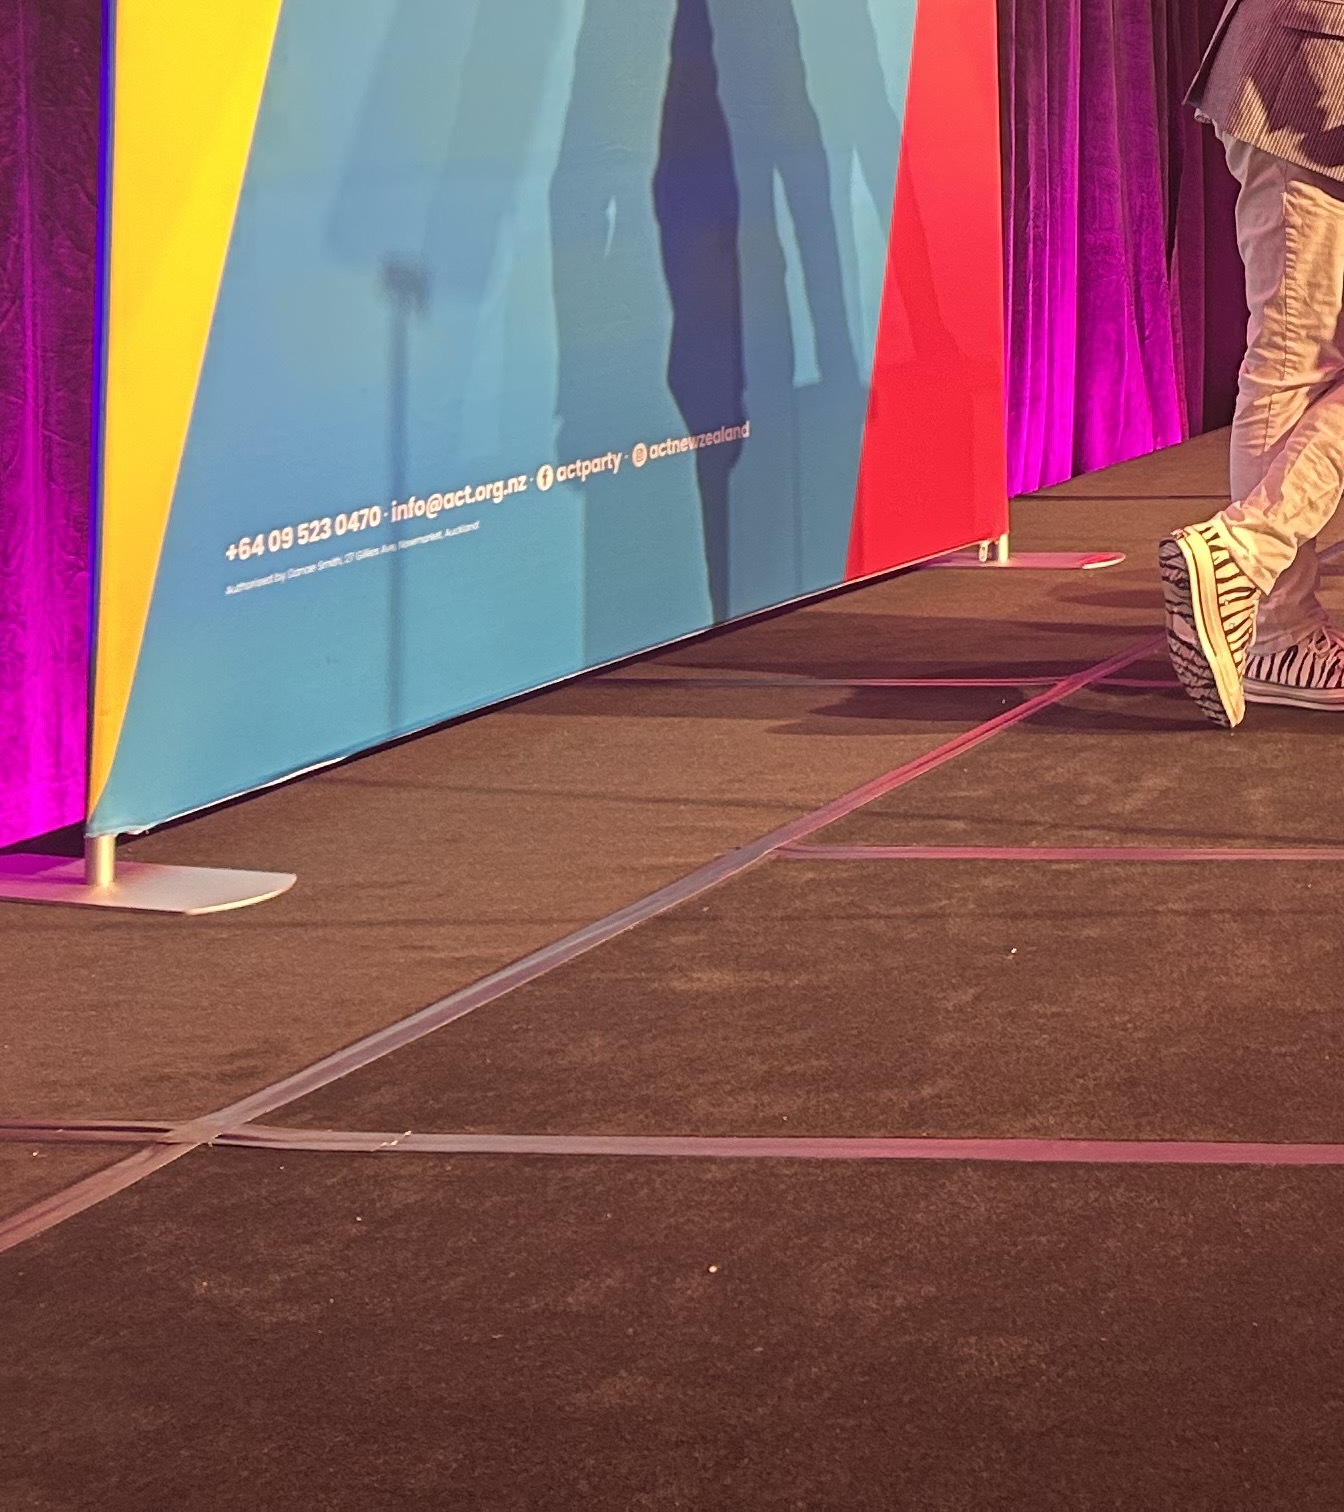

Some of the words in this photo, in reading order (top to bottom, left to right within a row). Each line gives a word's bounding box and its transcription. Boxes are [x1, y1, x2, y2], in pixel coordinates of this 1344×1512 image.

[225, 533, 265, 560] +64
[267, 526, 294, 552] 09
[297, 517, 332, 545] 523
[334, 505, 381, 535] 0470
[390, 474, 527, 523] info@act.org.nz
[556, 451, 623, 482] actparty
[649, 420, 750, 460] actnewzealand
